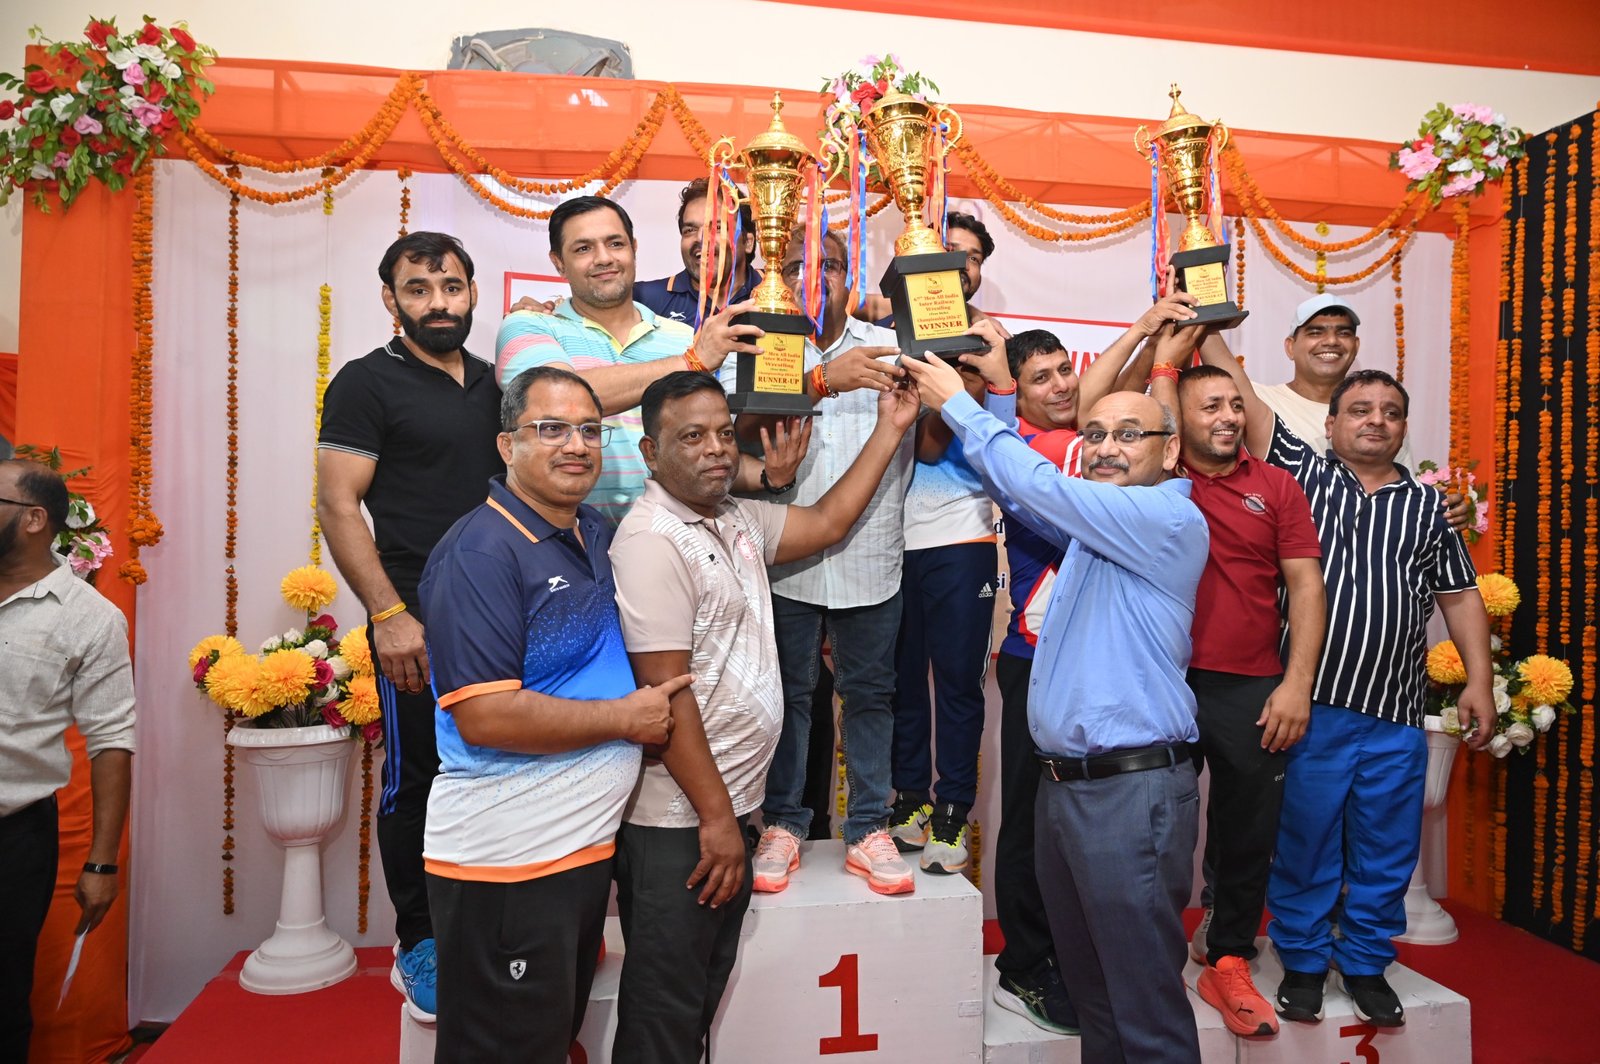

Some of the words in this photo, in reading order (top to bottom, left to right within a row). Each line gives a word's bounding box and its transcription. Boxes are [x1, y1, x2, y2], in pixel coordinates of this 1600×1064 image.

[918, 320, 964, 331] WINNER
[757, 376, 800, 385] RUNNER-UP
[819, 953, 879, 1056] 1
